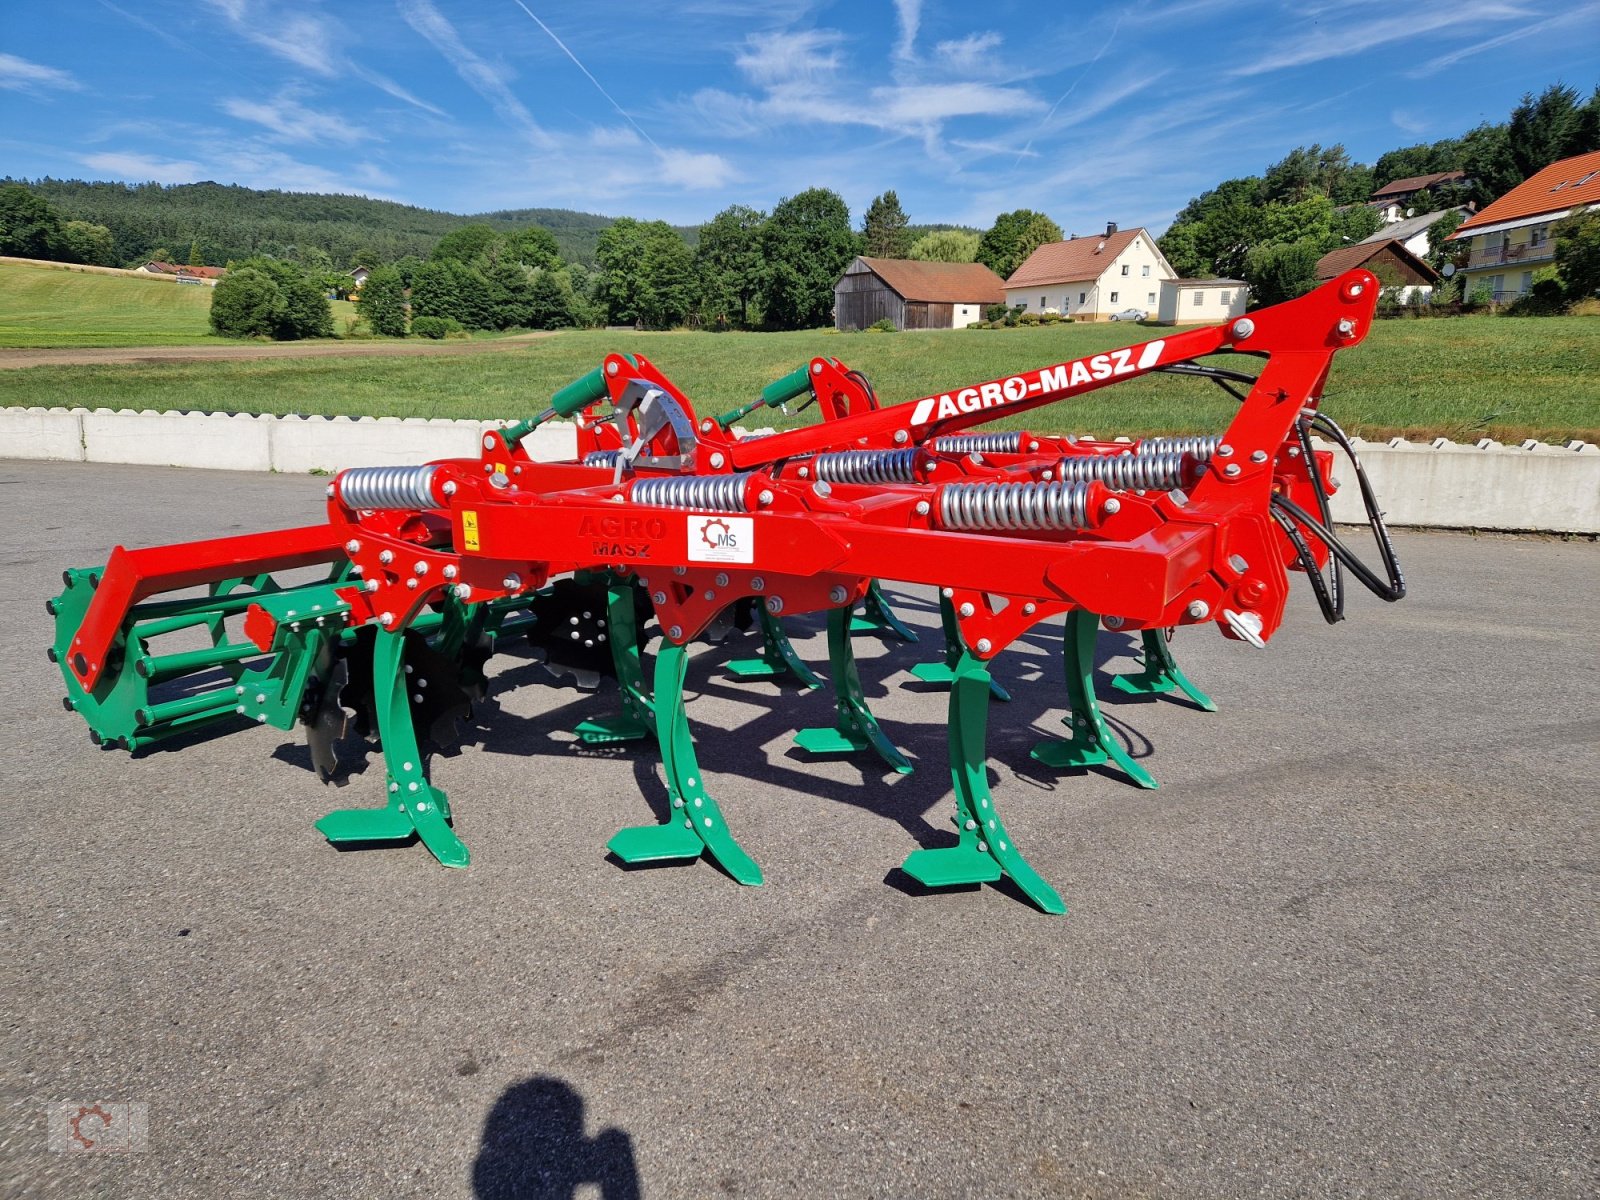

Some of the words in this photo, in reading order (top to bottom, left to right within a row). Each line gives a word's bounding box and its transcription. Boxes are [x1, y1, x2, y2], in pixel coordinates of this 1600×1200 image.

[937, 348, 1136, 418] AGRO-MASZ
[578, 516, 666, 540] AGRO
[592, 541, 650, 558] MASZ
